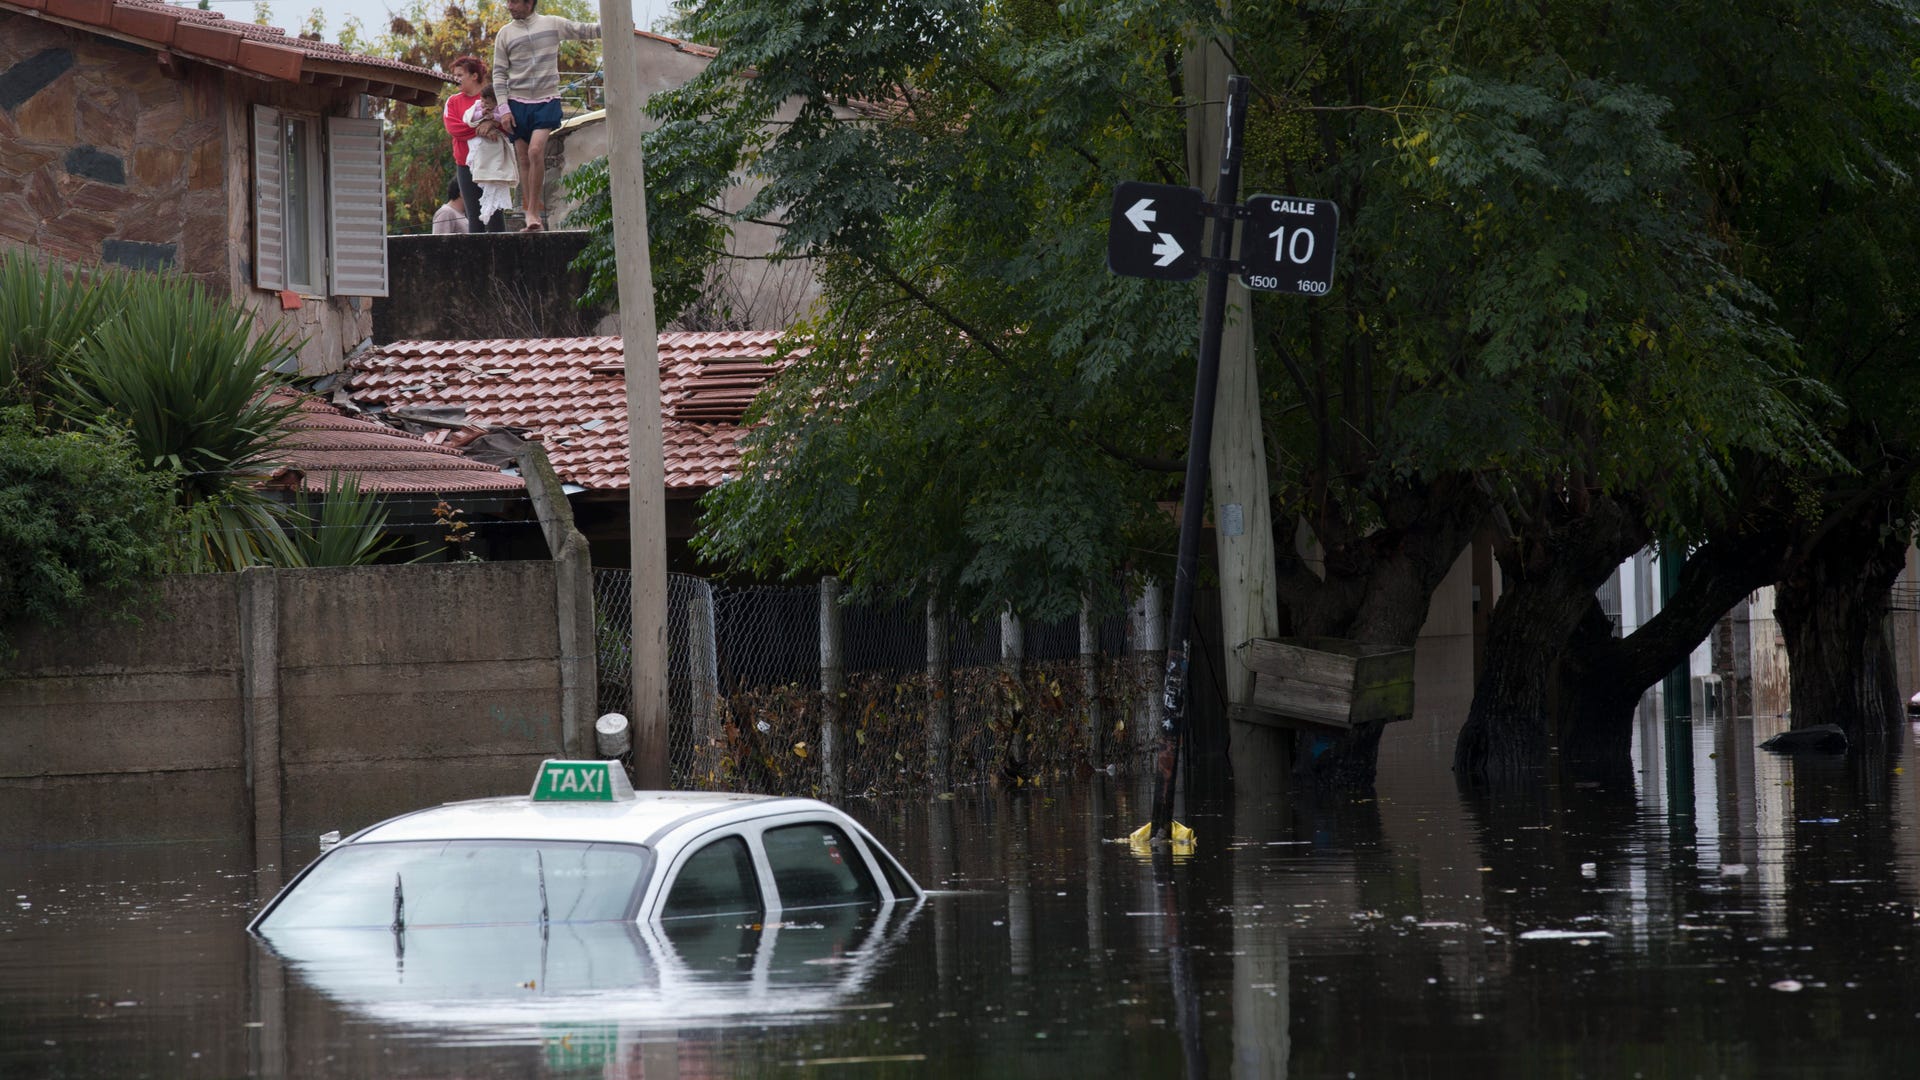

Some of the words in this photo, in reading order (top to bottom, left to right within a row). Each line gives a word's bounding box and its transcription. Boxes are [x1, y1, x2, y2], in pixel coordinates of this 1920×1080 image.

[1271, 199, 1315, 216] CALLE
[1269, 226, 1315, 264] 10
[1249, 275, 1278, 289] 1500
[1297, 279, 1327, 293] 1600
[547, 769, 604, 793] TAXI
